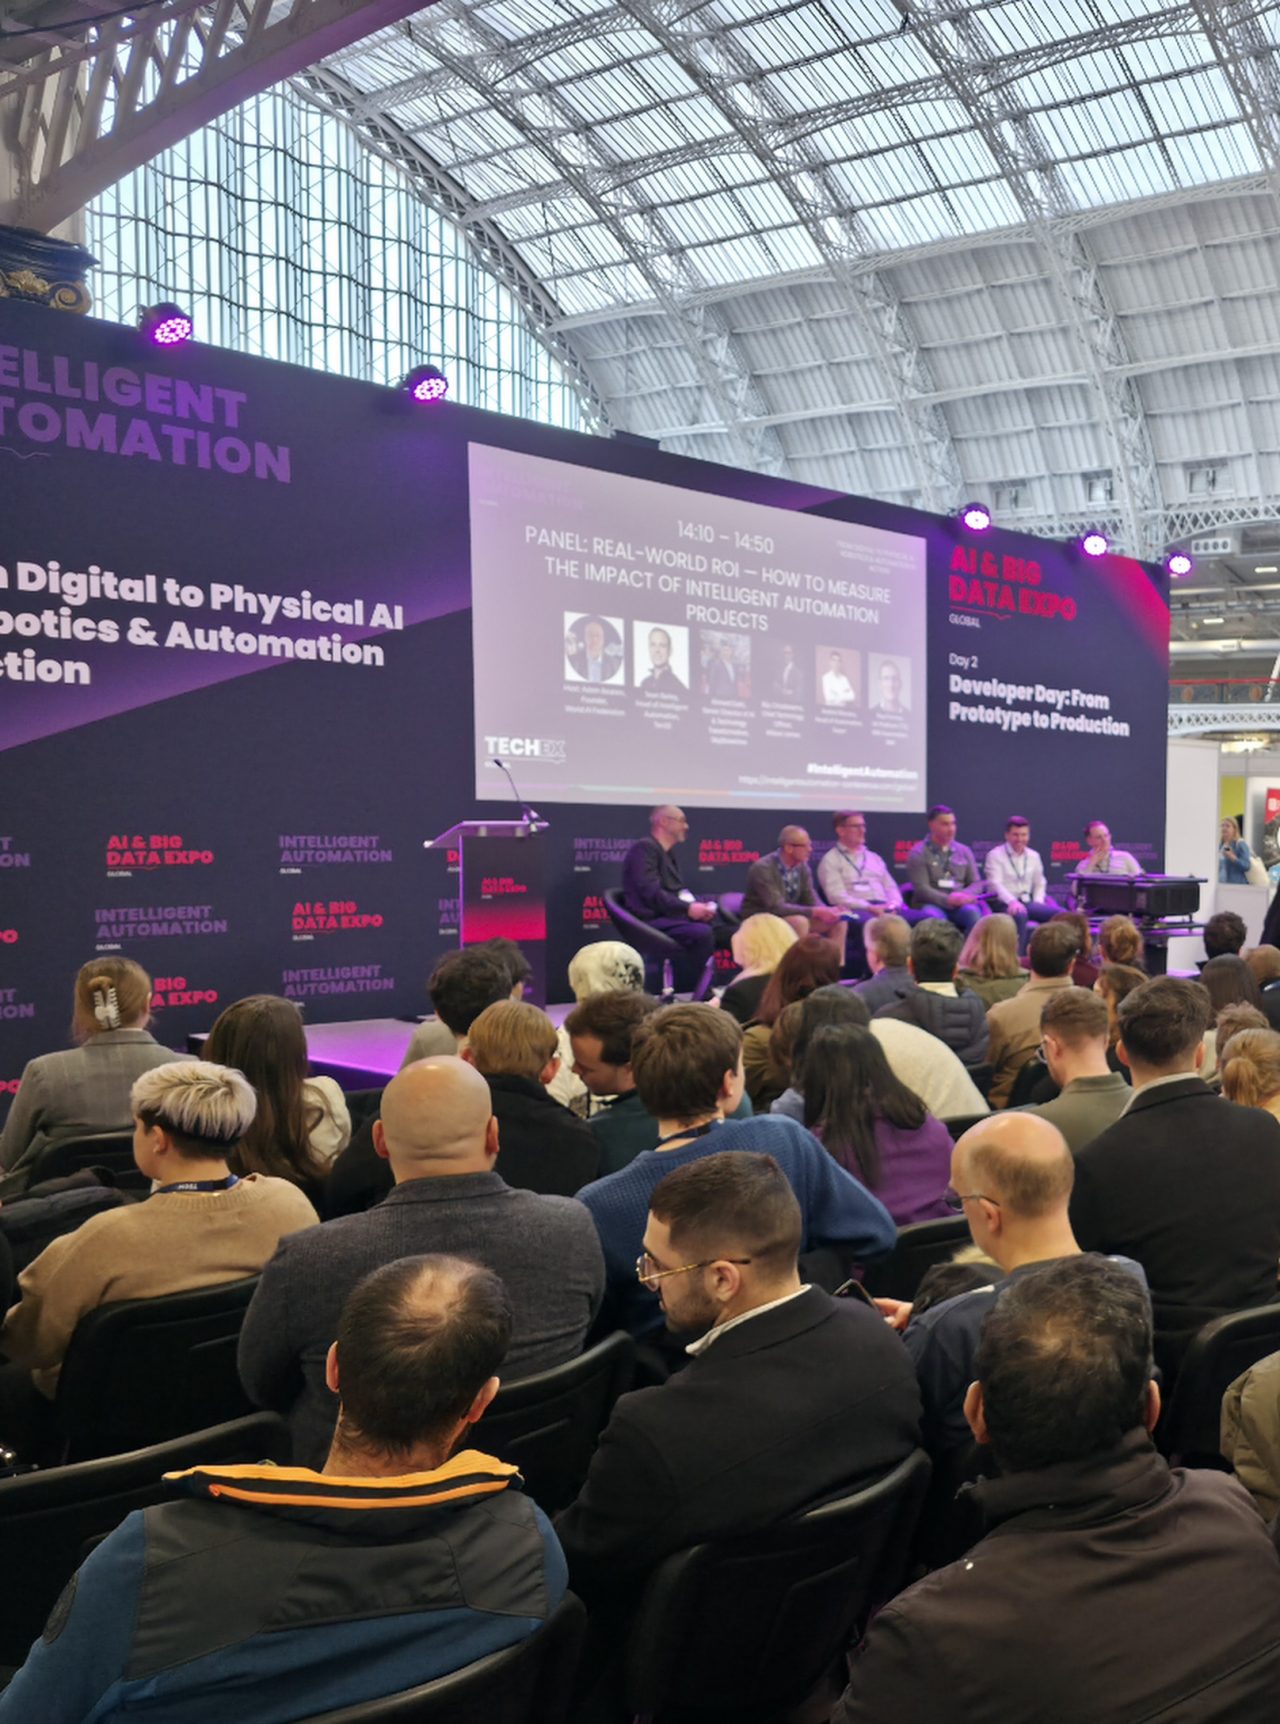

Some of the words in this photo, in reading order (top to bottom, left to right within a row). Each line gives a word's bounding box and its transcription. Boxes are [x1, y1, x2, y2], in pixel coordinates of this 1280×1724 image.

[678, 520, 714, 543] 14:10
[734, 531, 774, 554] 14:50
[525, 525, 588, 552] PANEL:
[593, 537, 707, 572] REAL-WORLD
[712, 558, 739, 578] ROI
[762, 567, 800, 588] HOW
[805, 574, 824, 592] TO
[828, 579, 891, 604] MEASURE
[951, 545, 976, 573] AI
[1003, 555, 1041, 585] BIG
[17, 561, 157, 605] Digital
[163, 577, 204, 608] to
[211, 582, 363, 625] Physical
[369, 604, 404, 631] AI
[545, 556, 579, 579] THE
[585, 563, 653, 589] IMPACT
[658, 575, 682, 593] OF
[686, 578, 779, 608] INTELLIGENT
[784, 595, 879, 624] AUTOMATION
[950, 575, 1016, 612] DATA
[1020, 588, 1077, 621] EXPO
[686, 604, 769, 631] PROJECTS
[949, 613, 981, 628] GLOBAL
[127, 617, 160, 648] &
[164, 620, 384, 667] Automation
[0, 648, 91, 685] tion
[949, 653, 969, 669] Day
[971, 656, 978, 668] 2
[950, 674, 1034, 705] Developer
[1035, 685, 1070, 710] Day:
[1071, 689, 1110, 710] From
[950, 702, 1031, 731] Prototype
[1033, 710, 1048, 728] to
[1051, 712, 1130, 737] Production
[108, 835, 128, 849] AI
[131, 835, 146, 848] &
[150, 835, 182, 849] BIG
[279, 835, 379, 848] INTELLIGENT
[107, 851, 161, 865] DATA
[164, 850, 214, 864] EXPO
[281, 850, 392, 863] AUTOMATION
[95, 906, 211, 922] INTELLIGENT
[292, 902, 311, 916] AI
[329, 901, 357, 915] BIG
[96, 920, 227, 938] AUTOMATION
[292, 916, 338, 930] DATA
[341, 914, 383, 928] EXPO
[283, 965, 382, 983] INTELLIGENT
[154, 976, 187, 992] BIG
[284, 978, 394, 997] AUTOMATION
[169, 989, 218, 1006] EXPO
